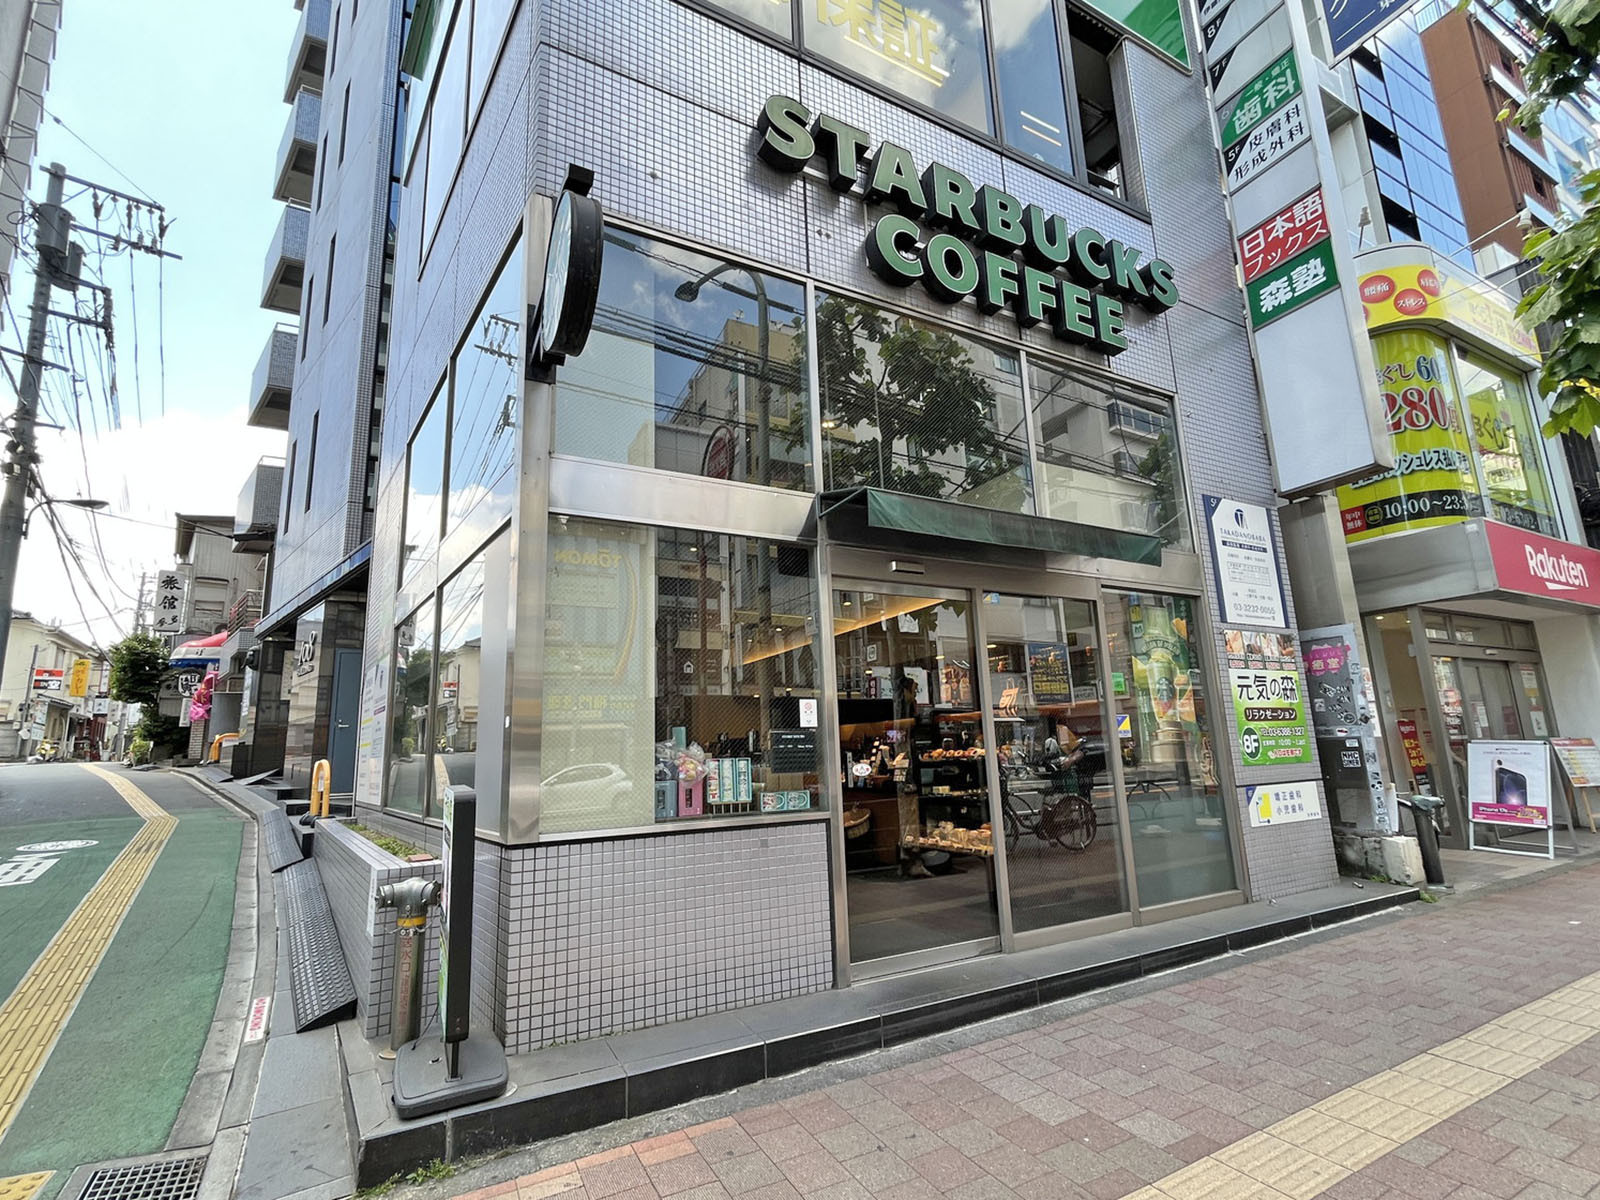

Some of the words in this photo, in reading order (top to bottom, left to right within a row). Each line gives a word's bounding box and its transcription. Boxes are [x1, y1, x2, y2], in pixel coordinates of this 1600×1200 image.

[1207, 17, 1222, 39] 8F
[1212, 58, 1227, 78] 7F
[1233, 68, 1296, 134] 歯科
[1249, 103, 1300, 153] 皮膚科
[1228, 145, 1241, 162] 5F
[1235, 121, 1305, 183] 形成外科
[758, 95, 1180, 313] STARBUCKS
[1242, 190, 1323, 259] 日本語
[1246, 219, 1327, 278] ブックス
[866, 214, 1129, 355] COFFEE
[1259, 257, 1327, 313] 森塾
[1524, 543, 1590, 588] Rakuten
[160, 574, 183, 611] 旅館
[1237, 673, 1299, 702] 元気の森
[1246, 708, 1296, 720] リラクゼーション
[1243, 734, 1259, 753] 8F
[1276, 803, 1304, 816] 小児歯科
